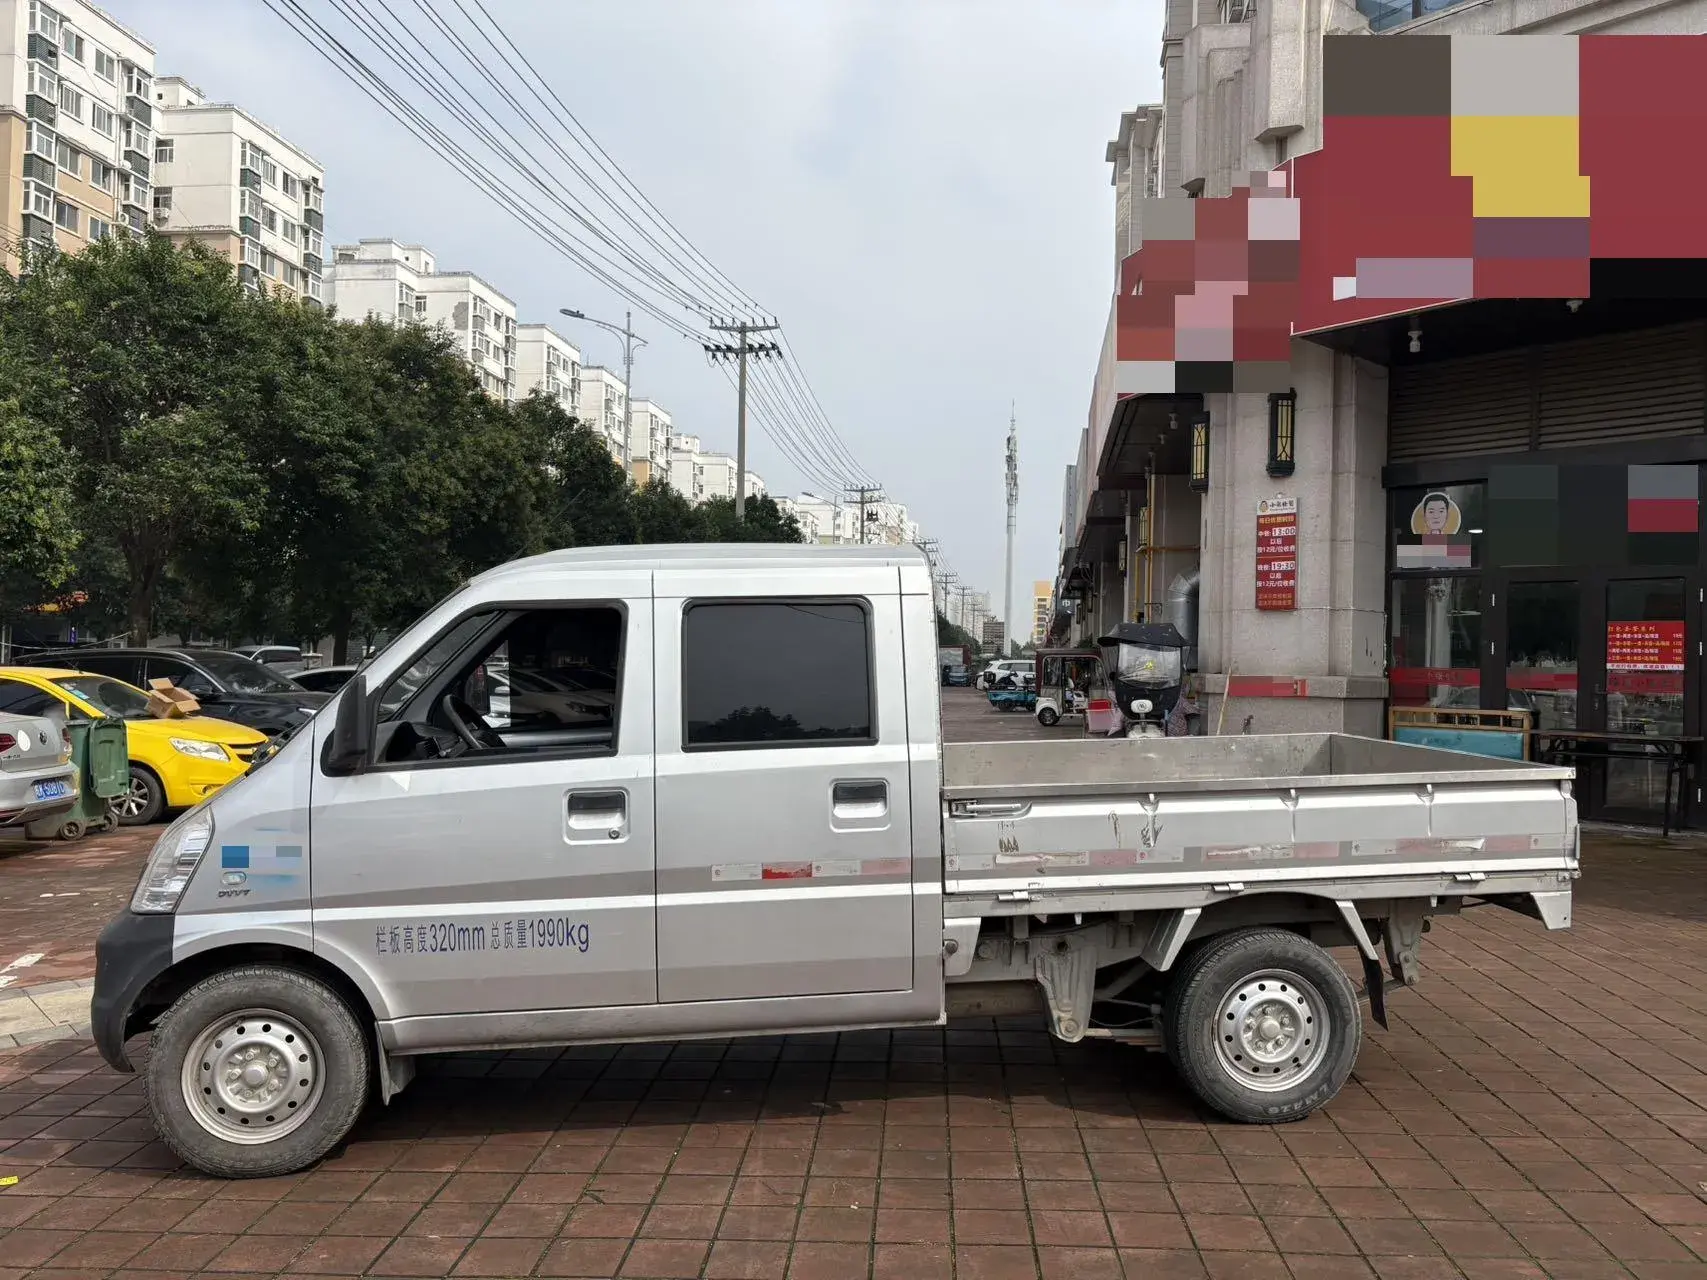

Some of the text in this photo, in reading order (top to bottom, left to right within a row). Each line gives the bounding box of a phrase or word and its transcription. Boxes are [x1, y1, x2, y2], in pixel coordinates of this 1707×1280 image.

[1273, 528, 1295, 536] 13:00
[1272, 562, 1295, 570] 19:30
[375, 917, 589, 955] 栏板高度320mm 总质量1990kg
